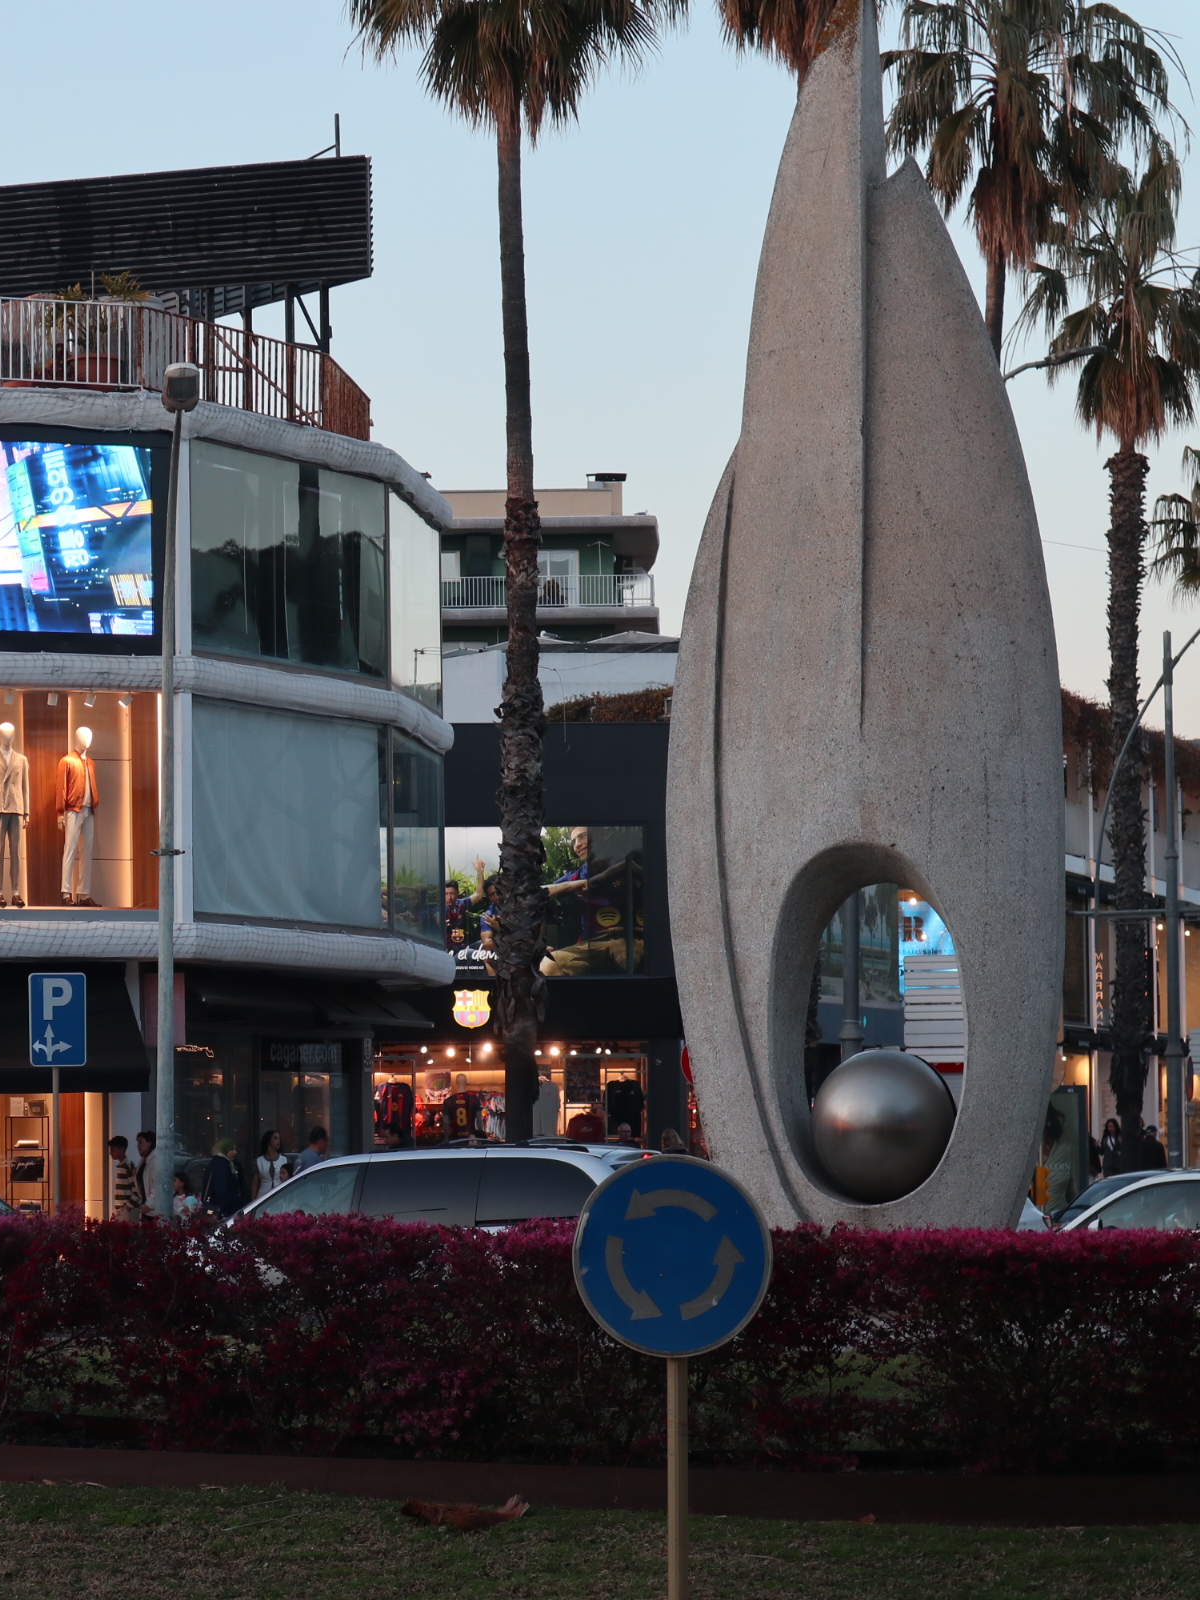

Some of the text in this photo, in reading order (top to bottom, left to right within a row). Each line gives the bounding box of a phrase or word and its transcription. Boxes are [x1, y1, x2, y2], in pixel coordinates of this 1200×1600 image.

[472, 943, 499, 961] dem
[43, 978, 73, 1020] P
[270, 1042, 337, 1069] caganer.com
[456, 1107, 467, 1126] 8
